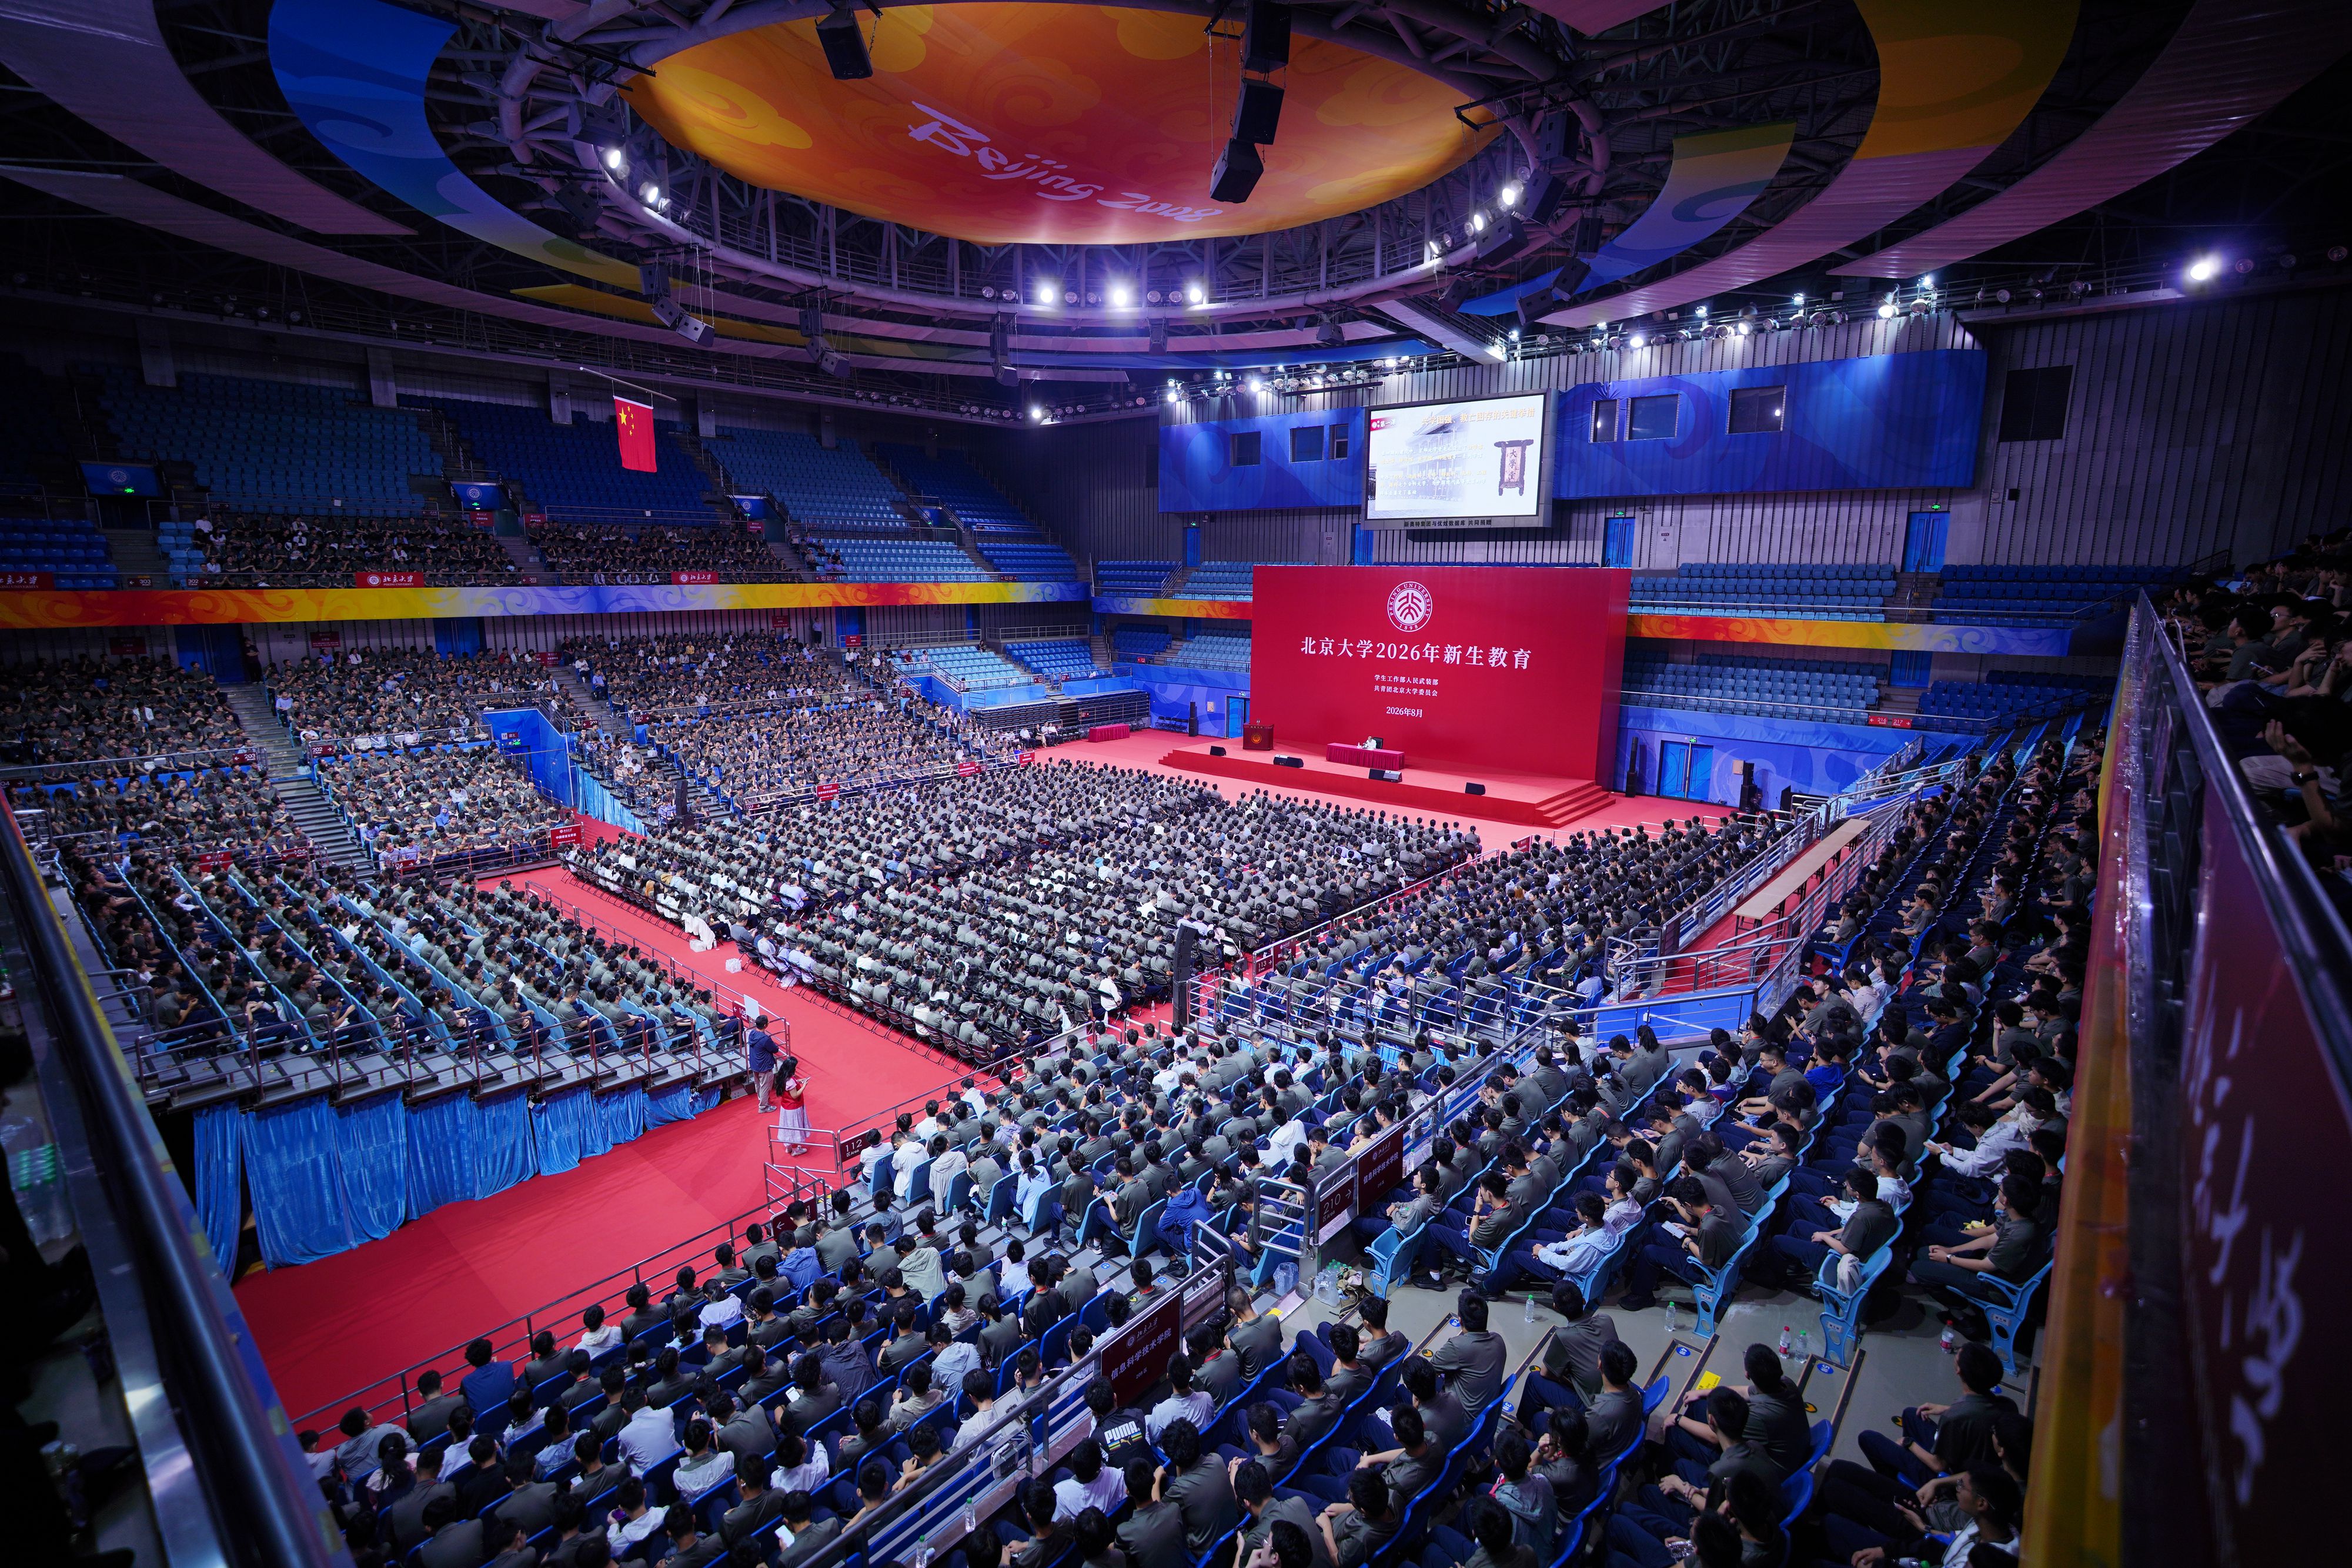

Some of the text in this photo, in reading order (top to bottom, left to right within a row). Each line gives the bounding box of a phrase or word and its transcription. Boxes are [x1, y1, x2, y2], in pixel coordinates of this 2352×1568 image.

[908, 100, 1224, 222] Beijing 2008
[383, 575, 413, 583] 北京大学
[1389, 583, 1431, 618] PEKING UNIVERSITY
[1301, 636, 1531, 670] 北京大学2026年新生教育
[1374, 674, 1439, 686] 学生工作部人民武装部
[1374, 685, 1438, 697] 共青团北京大学委员会
[1386, 706, 1423, 718] 2026年8月
[1258, 960, 1267, 968] 113
[846, 1139, 862, 1152] 112
[1363, 1152, 1399, 1185] 信息科学技术学院
[1324, 1193, 1341, 1216] 210
[1137, 1317, 1158, 1339] 北京大学
[1111, 1327, 1172, 1380] 信息科学技术学院
[1104, 1420, 1138, 1445] PUMA
